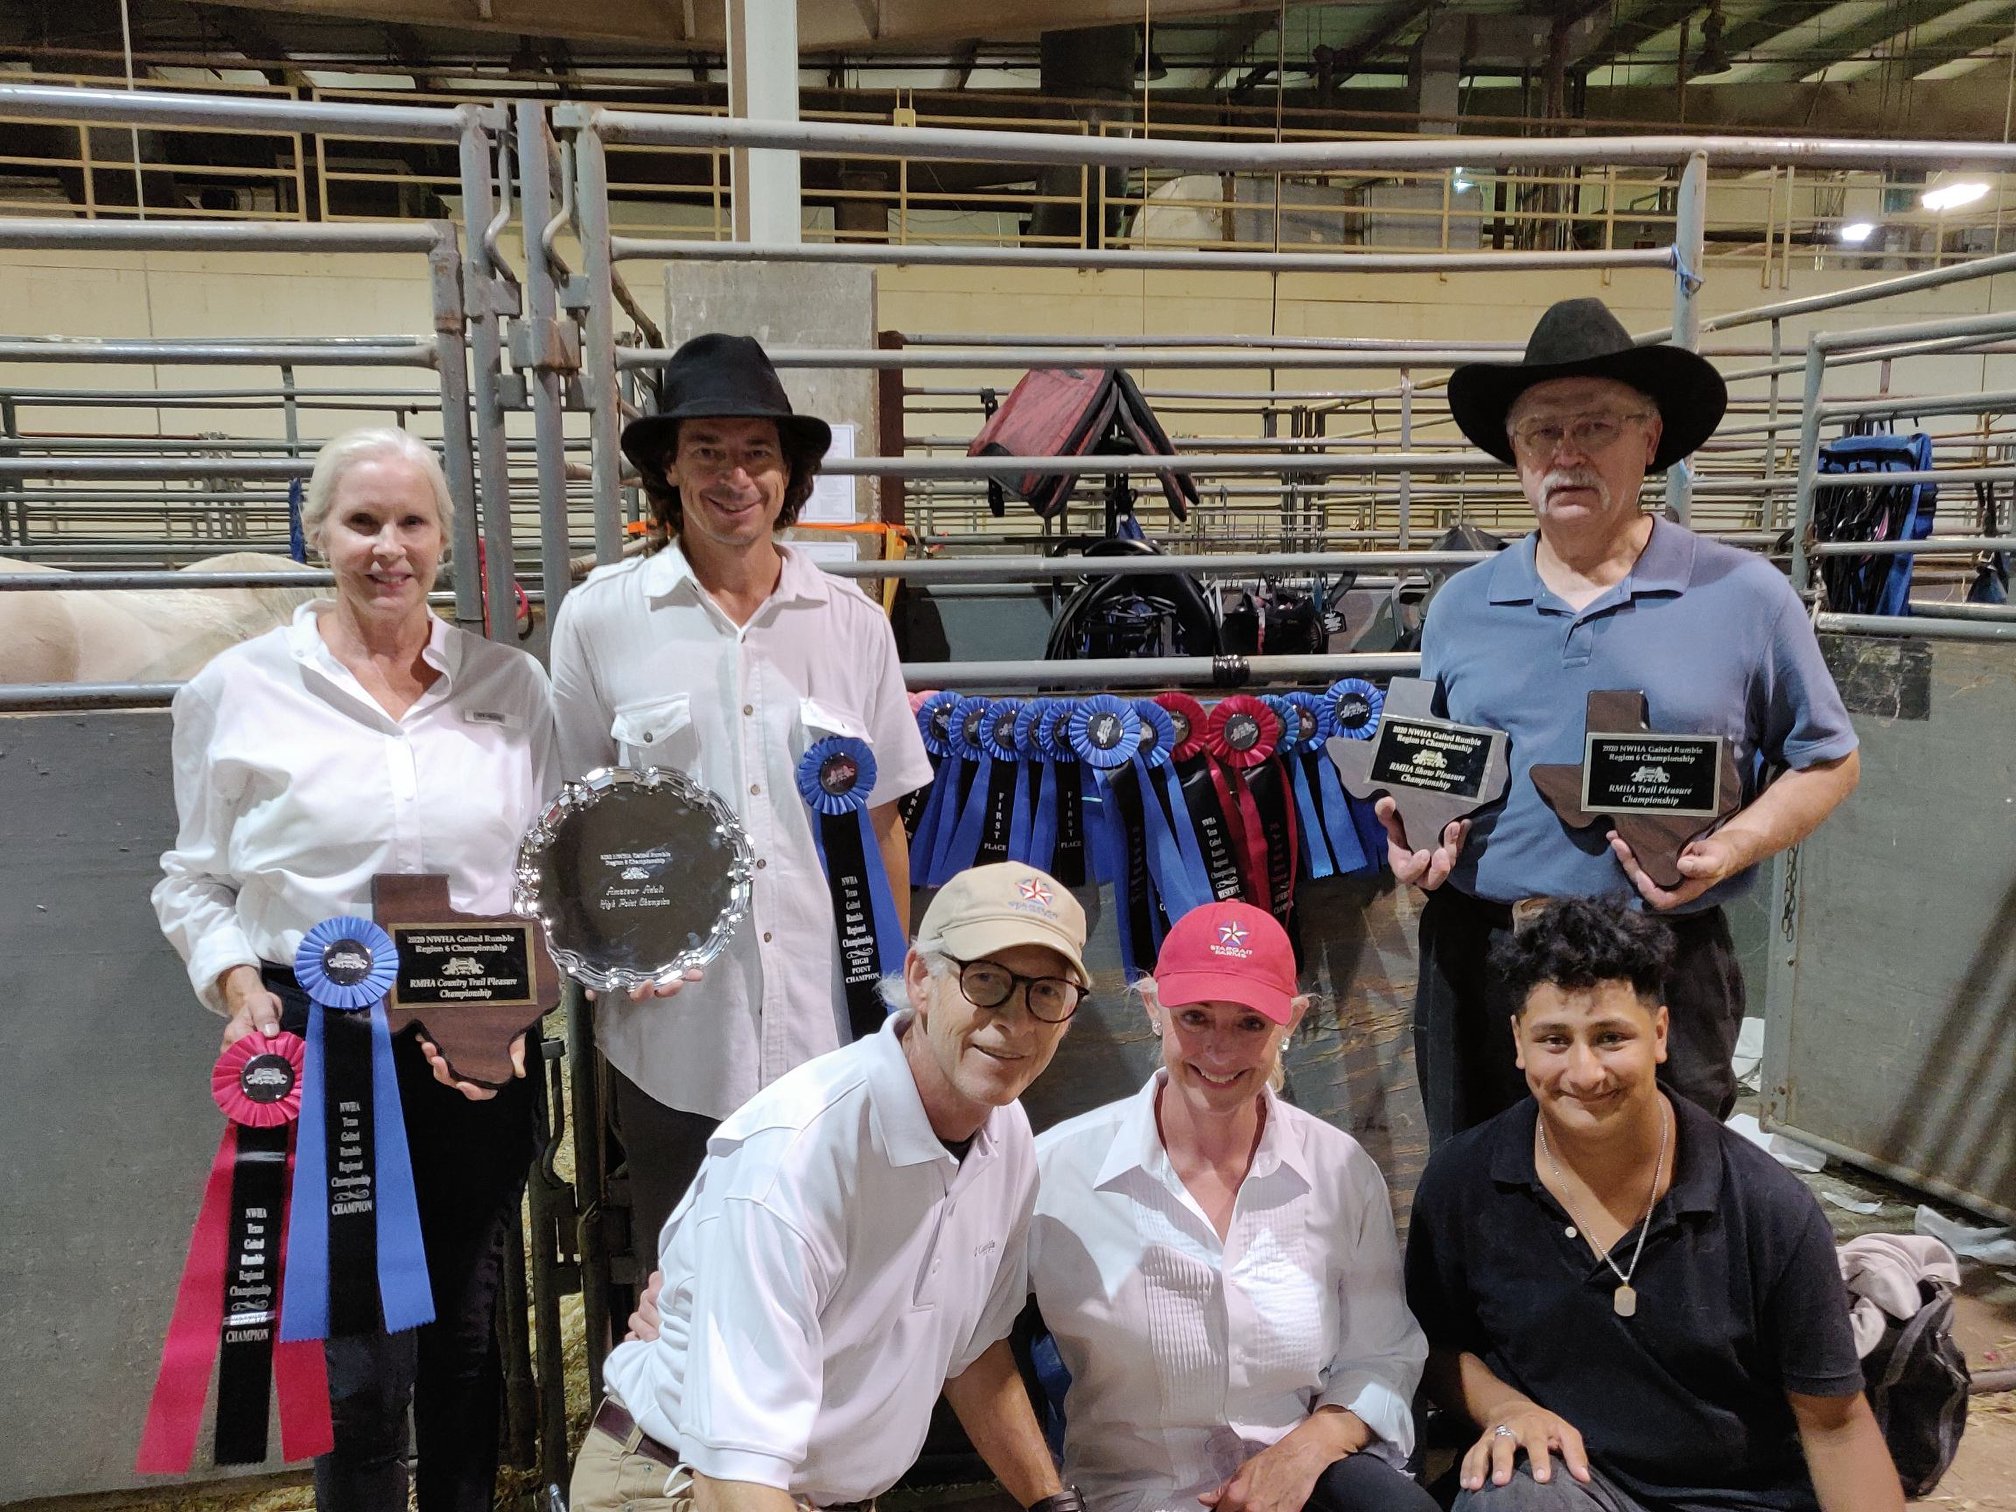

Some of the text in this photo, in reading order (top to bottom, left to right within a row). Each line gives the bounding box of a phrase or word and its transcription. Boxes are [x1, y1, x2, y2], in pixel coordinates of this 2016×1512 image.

[1408, 727, 1432, 739] NWHA
[1432, 732, 1456, 743] Gaited
[1455, 734, 1482, 747] Rumble
[1397, 734, 1421, 745] Region
[1425, 739, 1473, 754] Championship
[1620, 745, 1646, 753] NWHA
[1648, 746, 1673, 754] Gaited
[1674, 747, 1703, 755] Rumble
[1609, 754, 1635, 763] Region
[1641, 754, 1695, 764] Championship
[1414, 766, 1435, 777] Show
[1435, 769, 1466, 782] Pleasure
[1400, 774, 1451, 790] Championship
[1637, 785, 1657, 794] Trail
[1658, 786, 1692, 795] Pleasure
[1622, 795, 1680, 807] Championship
[993, 792, 1005, 839] FIRST
[983, 842, 1007, 851] PLACE
[841, 876, 858, 886] NWHA
[426, 935, 455, 943] NWHA
[484, 934, 515, 942] Rumble
[415, 945, 444, 954] Region
[451, 944, 508, 953] Championship
[852, 957, 869, 966] HIGH
[852, 965, 871, 975] POINT
[845, 972, 881, 984] CHAMPION
[410, 978, 518, 989] RMHA Country Trail Pleasure
[440, 989, 492, 999] Championship
[331, 1200, 373, 1216] CHAMPION
[226, 1329, 269, 1343] CHAMPION
